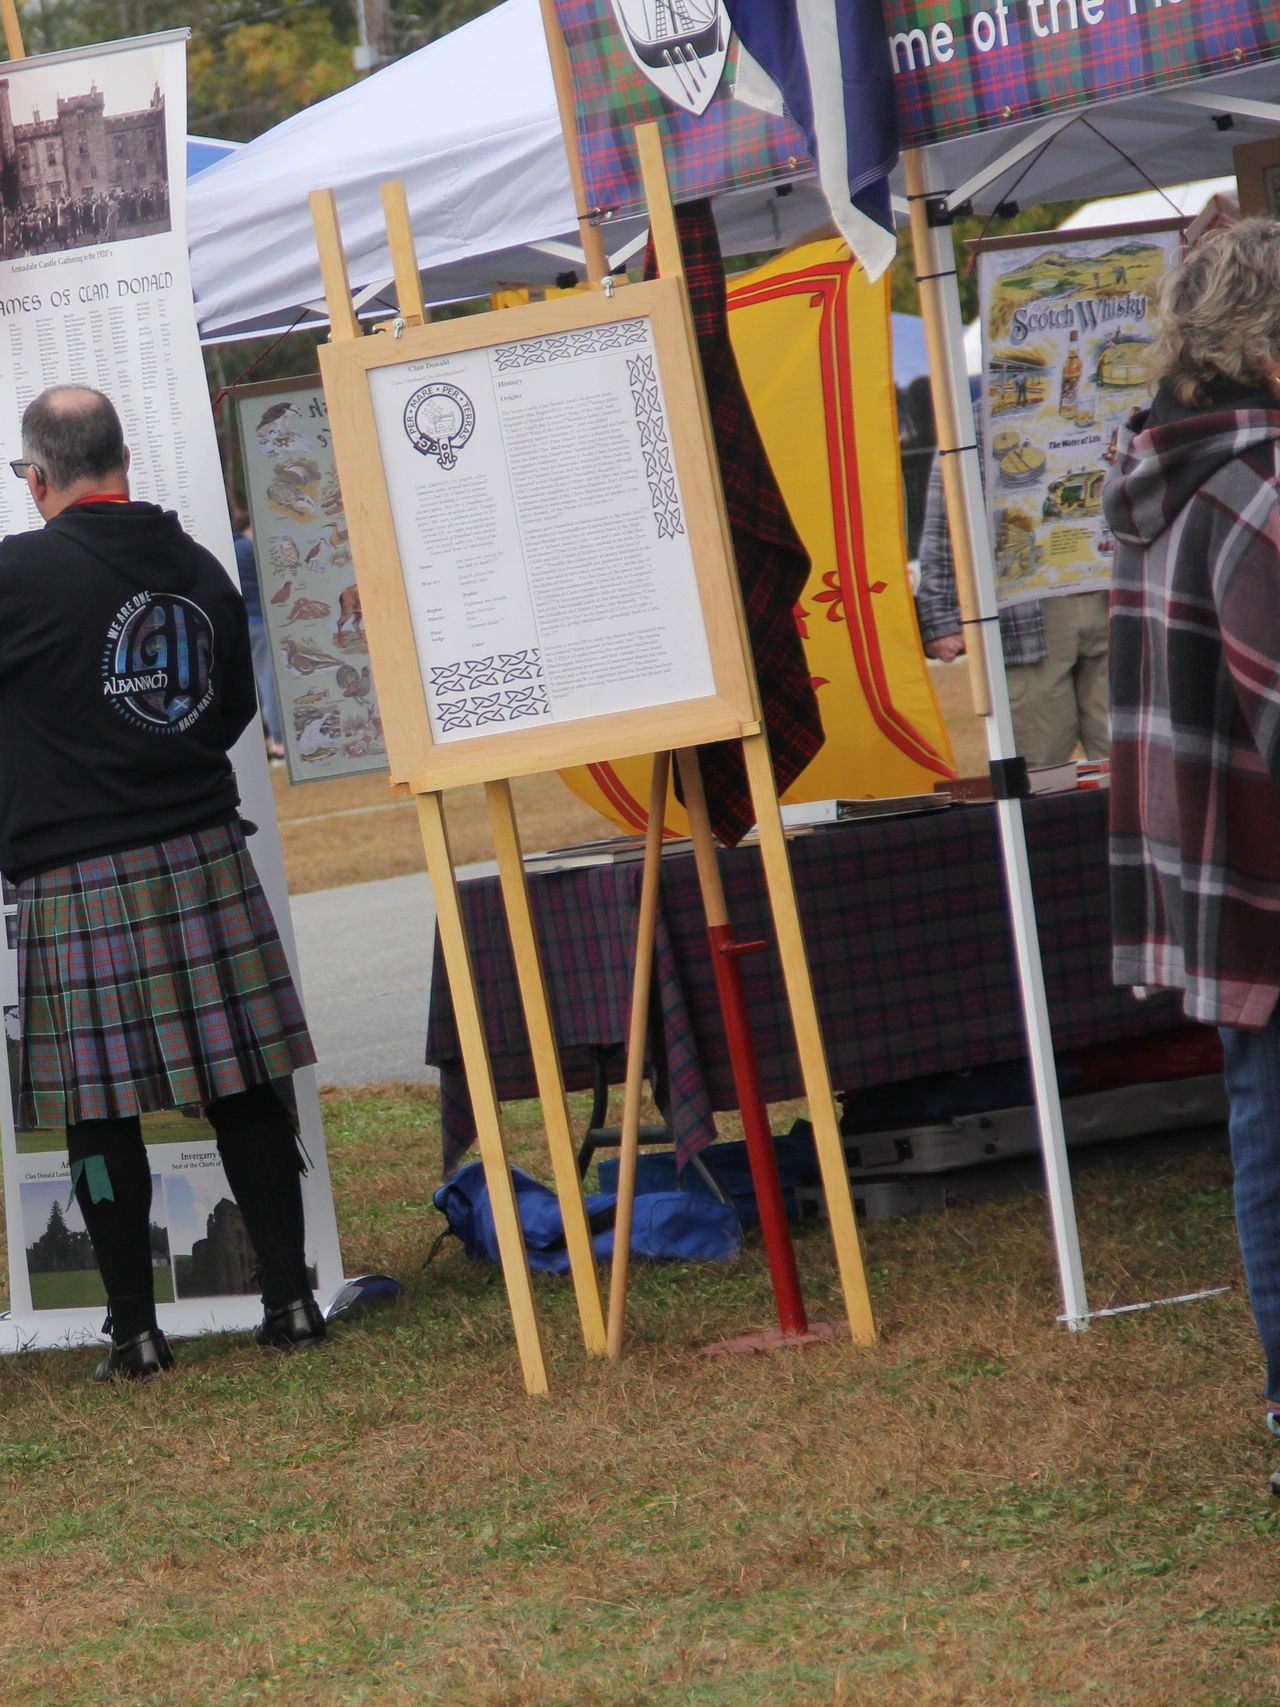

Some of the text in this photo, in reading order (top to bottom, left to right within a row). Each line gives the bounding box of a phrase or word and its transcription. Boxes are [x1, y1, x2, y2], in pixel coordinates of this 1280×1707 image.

[889, 0, 1106, 74] me of the
[10, 262, 37, 273] Armadale
[38, 258, 57, 268] Castle
[58, 252, 83, 266] Gathering
[51, 288, 71, 307] OF
[78, 282, 109, 303] CLAN
[117, 271, 173, 297] DONALD
[1012, 294, 1146, 344] Scotch Whisky
[408, 359, 450, 373] Clan Donald
[498, 377, 523, 388] History
[406, 386, 473, 441] PER MARE PER TERRAS
[1049, 441, 1062, 450] The
[1062, 438, 1080, 448] Water
[1088, 434, 1102, 444] Life
[107, 590, 152, 640] WE ARE ONE
[178, 708, 200, 732] NACH
[180, 1152, 217, 1162] Invergarry
